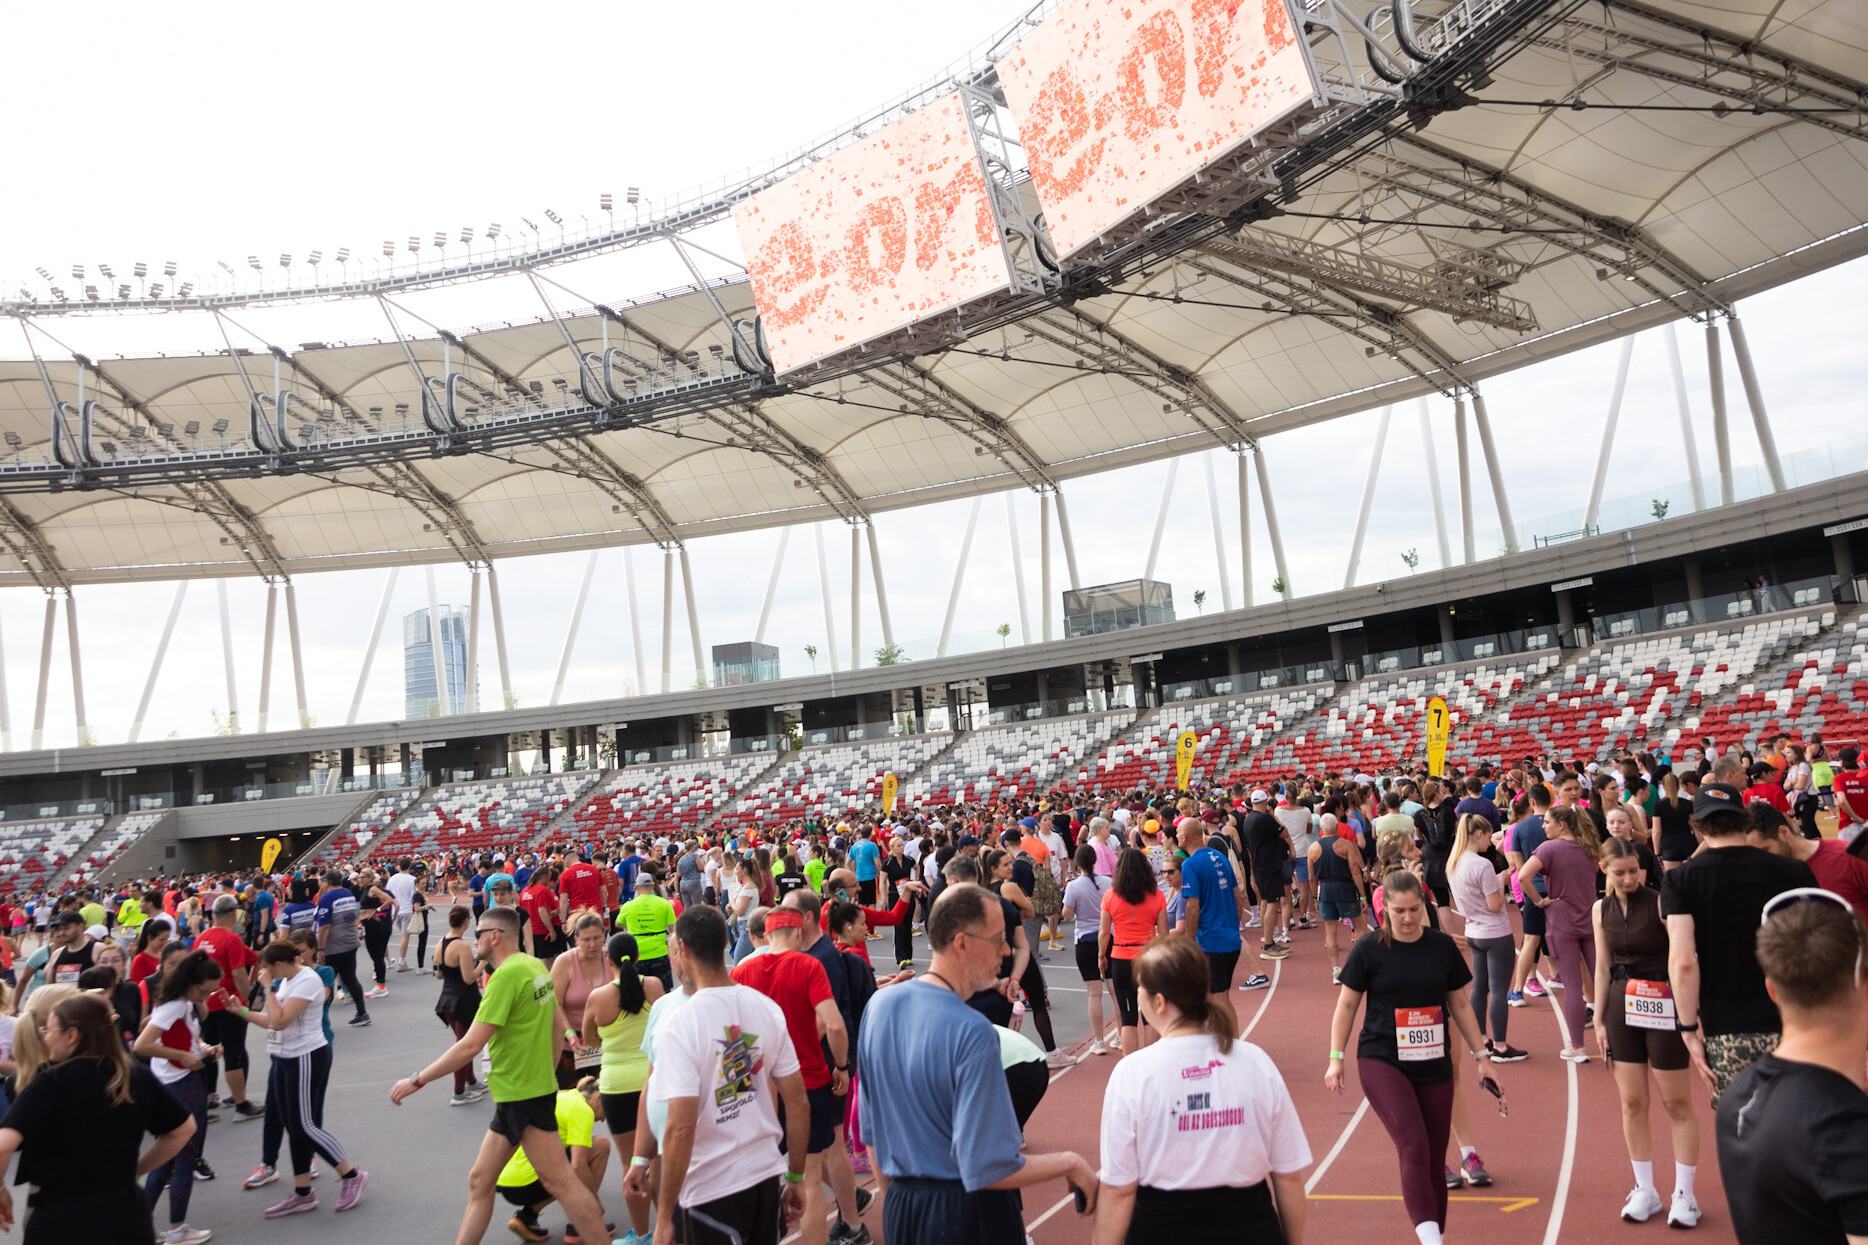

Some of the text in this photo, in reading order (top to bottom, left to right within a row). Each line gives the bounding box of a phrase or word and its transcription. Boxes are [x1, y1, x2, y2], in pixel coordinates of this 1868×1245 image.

[1433, 708, 1442, 728] 7
[1184, 737, 1193, 749] 6
[888, 780, 893, 788] 5
[1636, 1000, 1663, 1014] 6938
[1409, 1029, 1434, 1044] 6931
